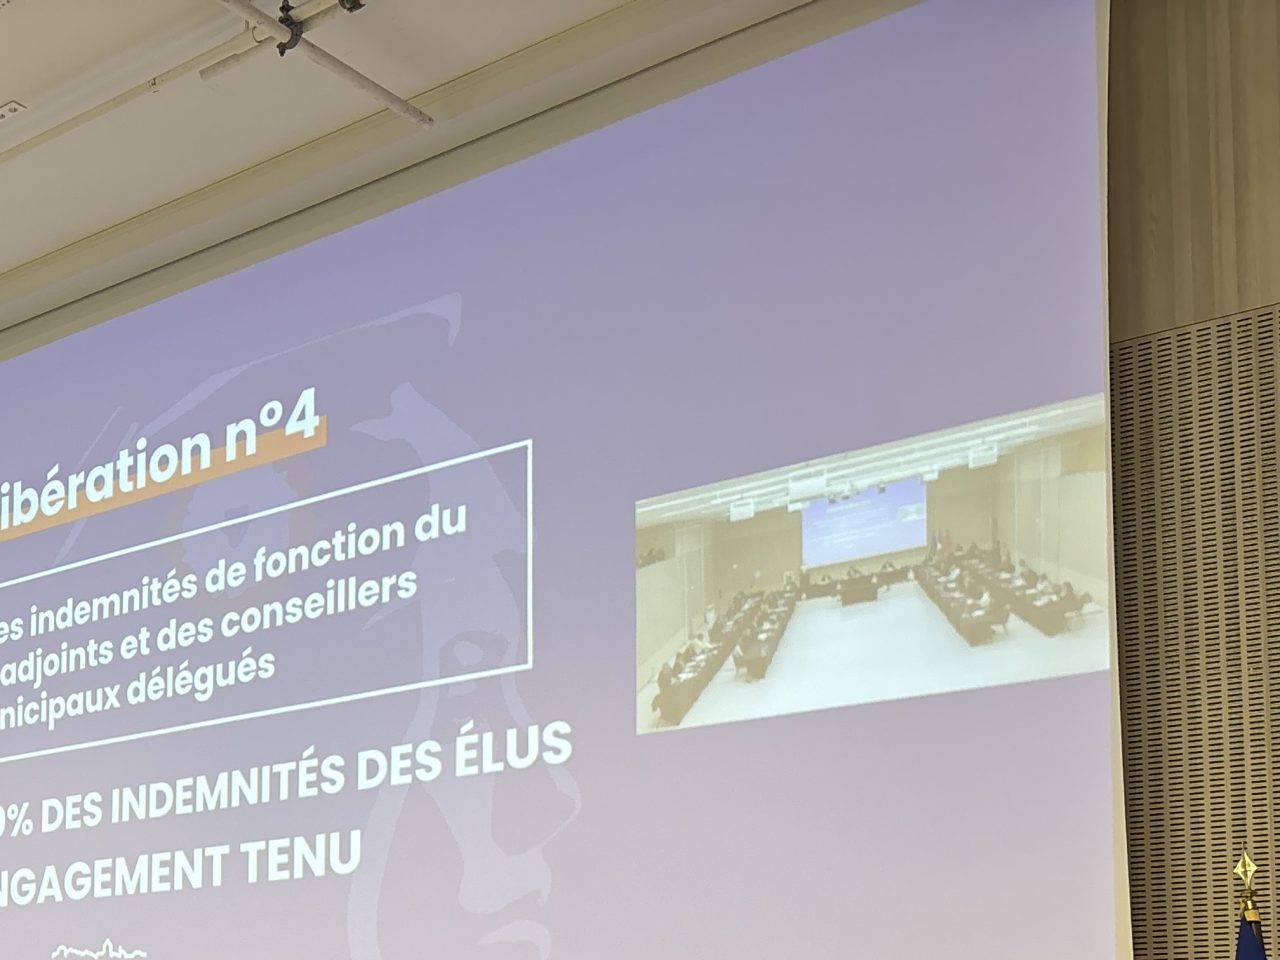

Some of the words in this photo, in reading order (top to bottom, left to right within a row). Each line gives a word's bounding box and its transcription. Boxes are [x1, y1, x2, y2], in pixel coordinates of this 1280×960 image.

[30, 567, 198, 637] indemnités
[205, 558, 247, 593] de
[253, 521, 405, 582] fonction
[414, 503, 466, 542] du
[0, 638, 114, 690] adjoints
[120, 626, 151, 660] et
[156, 617, 214, 652] des
[220, 571, 418, 638] conseillers
[126, 646, 275, 705] délégués
[41, 791, 103, 833] DES
[111, 744, 345, 824] INDEMNITÉS
[357, 739, 443, 791] DES
[455, 719, 573, 778] ÉLUS
[239, 829, 361, 884] TENU
